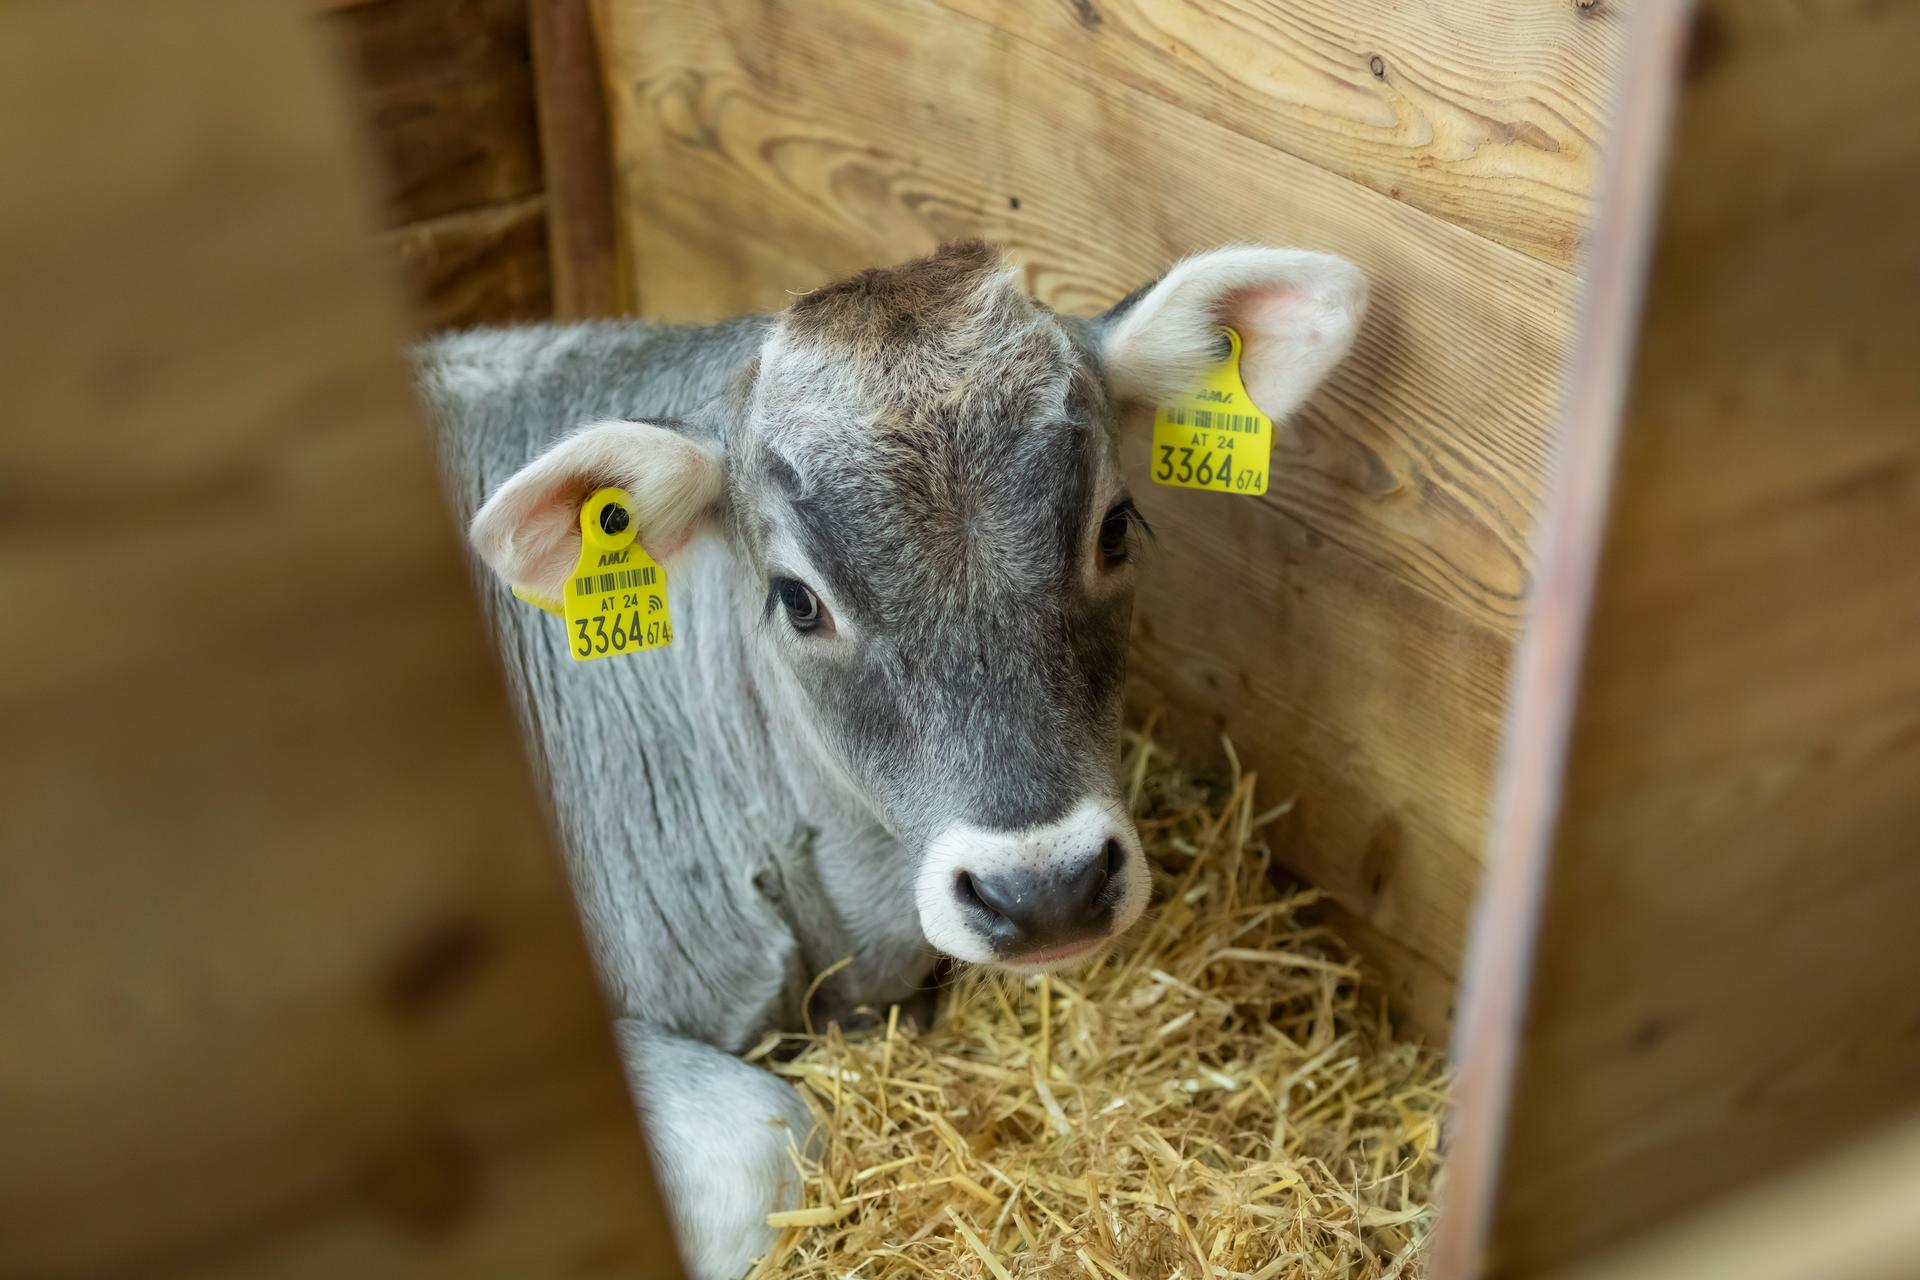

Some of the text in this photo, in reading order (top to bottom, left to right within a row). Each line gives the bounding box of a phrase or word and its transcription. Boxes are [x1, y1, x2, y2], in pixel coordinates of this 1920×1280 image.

[1191, 433, 1234, 450] AT 24
[1156, 445, 1262, 492] 3364 674
[601, 593, 639, 612] AT 24
[575, 610, 669, 657] 3364 674
